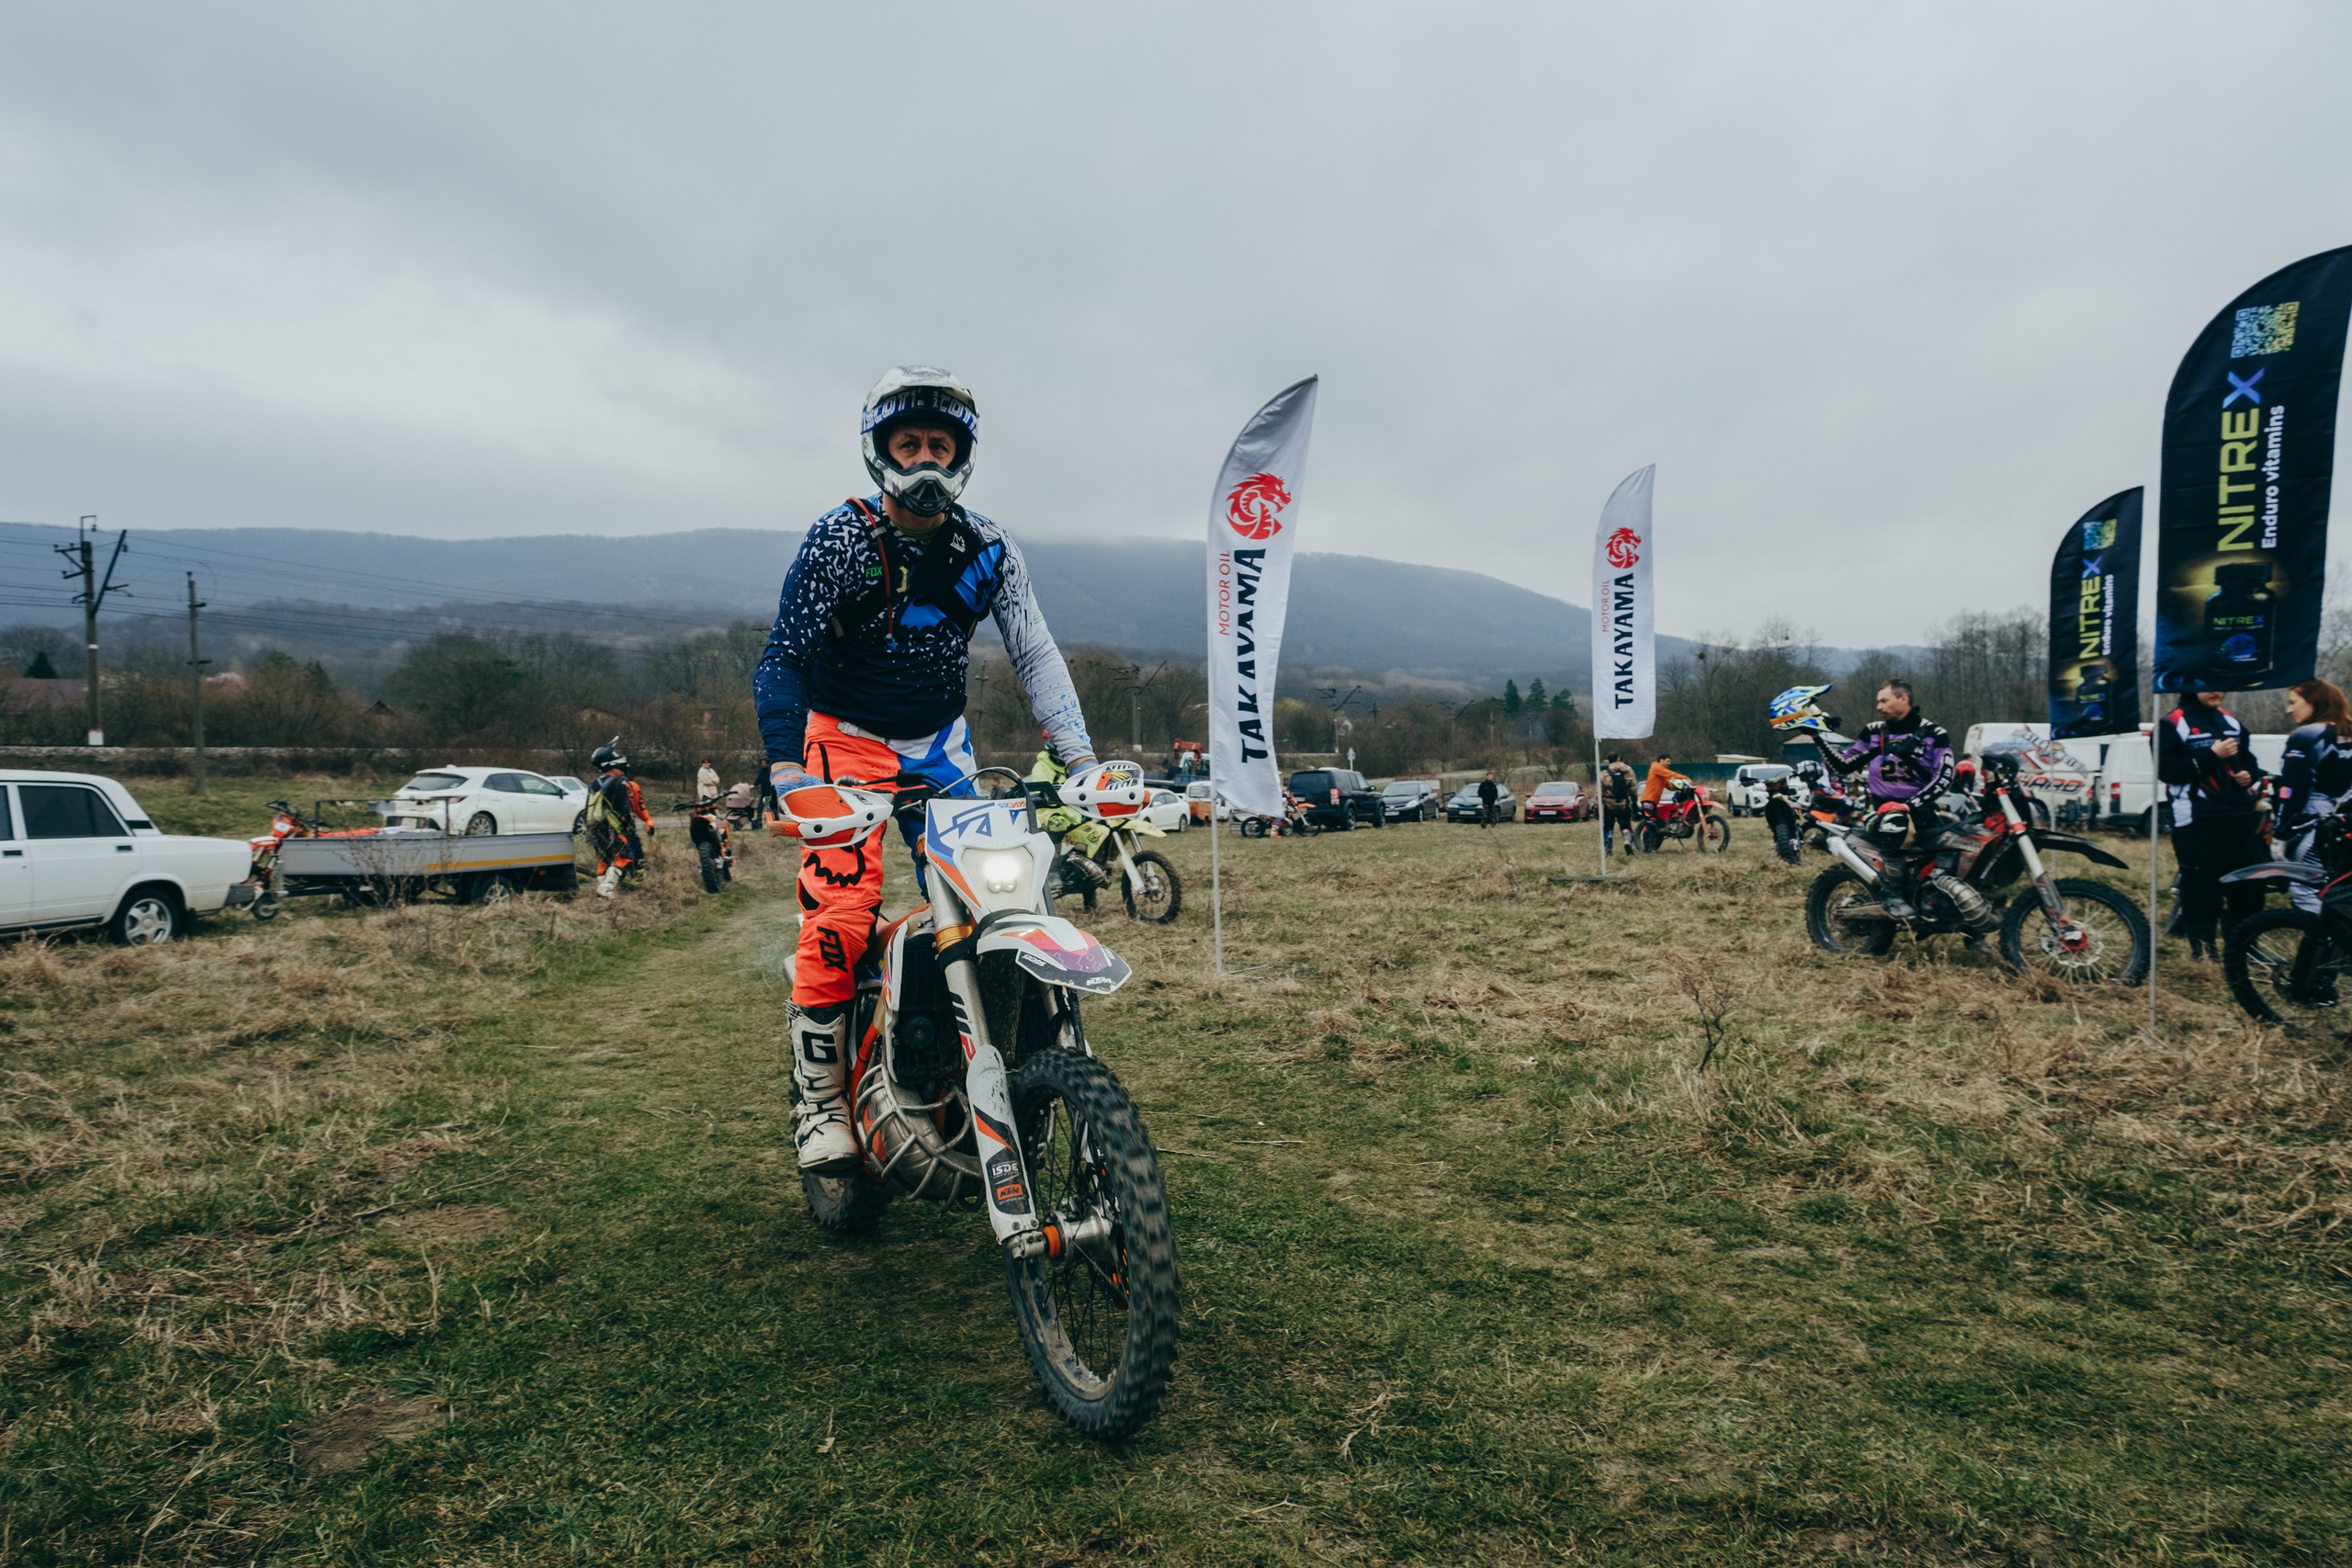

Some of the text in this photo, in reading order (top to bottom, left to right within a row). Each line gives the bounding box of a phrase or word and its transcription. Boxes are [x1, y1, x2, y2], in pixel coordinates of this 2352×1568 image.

[2217, 367, 2266, 551] NITREX
[2261, 405, 2285, 548] Enduro vitamins
[865, 566, 883, 578] FOX
[1218, 549, 1230, 636] MOTOR OIL
[1601, 579, 1610, 632] MOTOR OIL
[2079, 556, 2102, 659] NITREX
[2102, 574, 2114, 655] Enduro vitamins
[1234, 548, 1268, 763] TAKAYAMA
[1614, 572, 1634, 710] TAKAYAMA
[817, 926, 848, 974] FOX
[992, 1162, 1018, 1177] ISDE
